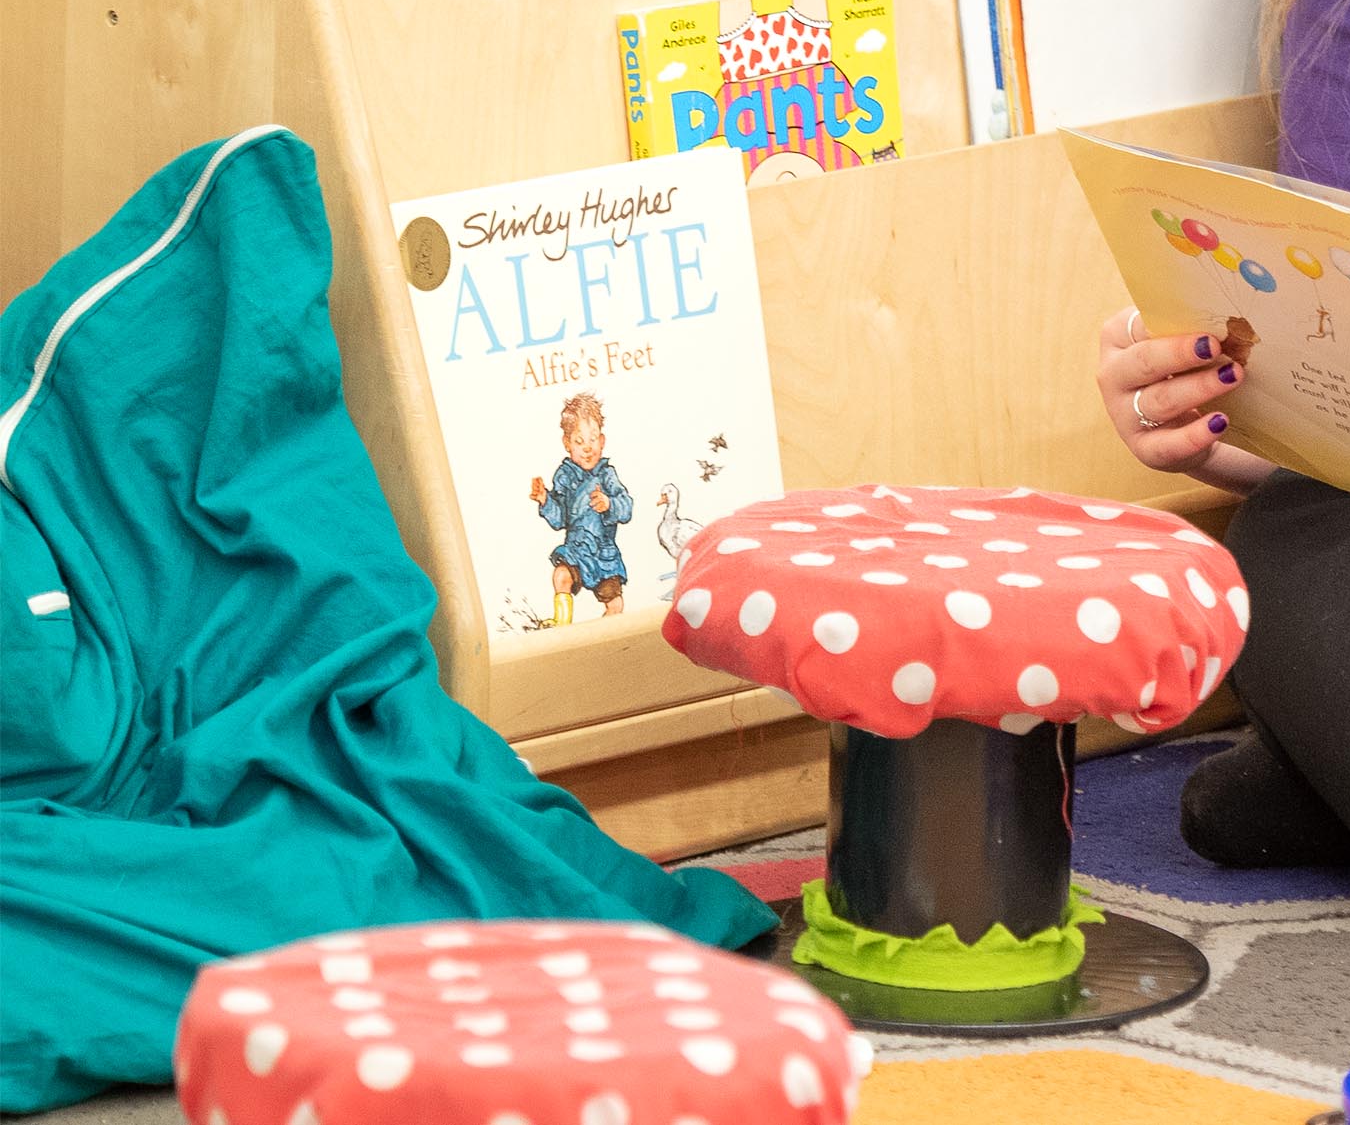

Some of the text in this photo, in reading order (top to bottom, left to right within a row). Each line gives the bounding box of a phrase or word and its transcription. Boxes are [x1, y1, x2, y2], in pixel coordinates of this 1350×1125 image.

[661, 35, 707, 51] Andreae
[670, 18, 697, 33] Giles
[620, 28, 646, 124] Pants
[671, 66, 885, 153] Pants
[457, 185, 679, 262] Shirley Hughes
[445, 222, 719, 362] ALFIE
[521, 341, 657, 391] Alfie's Feet
